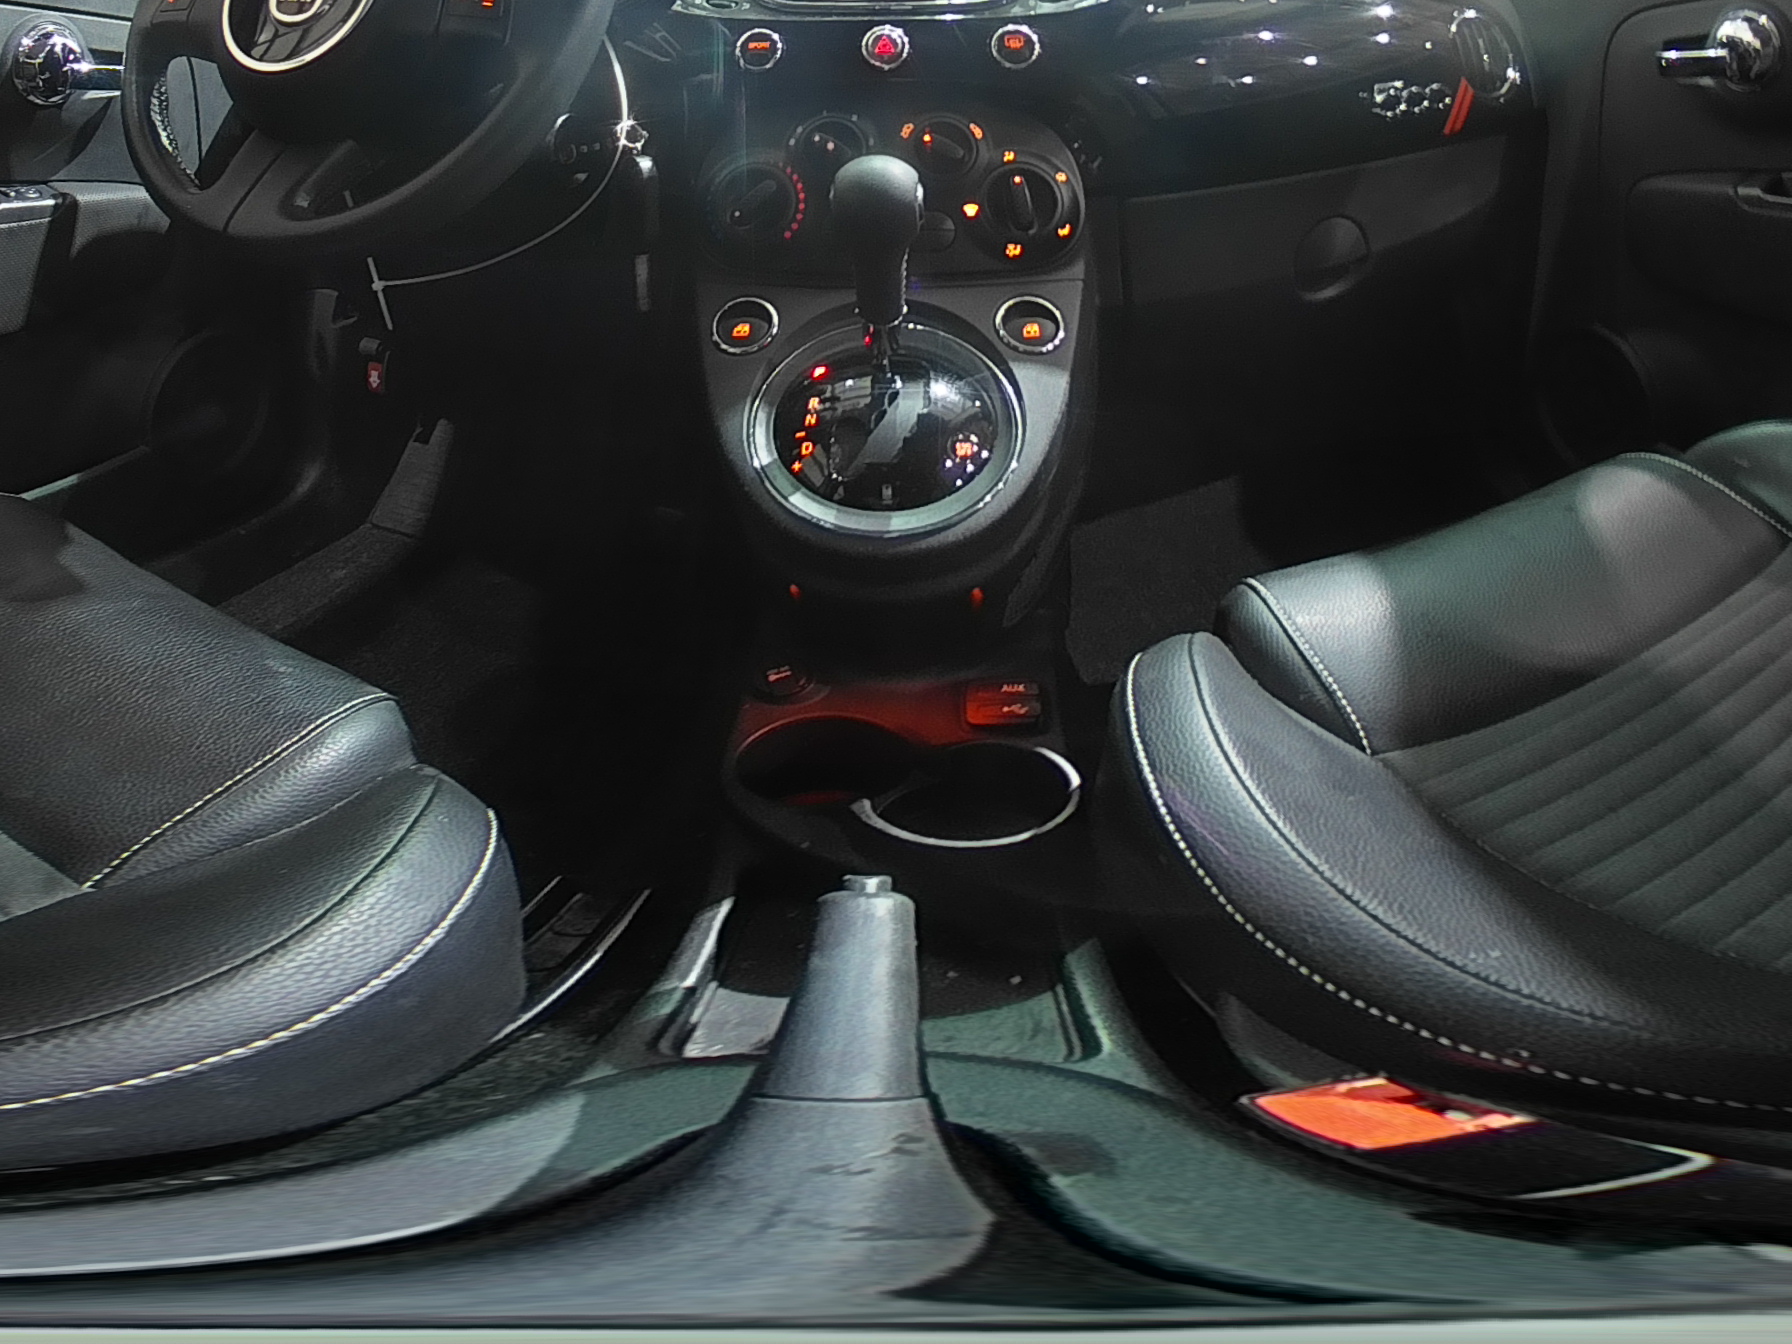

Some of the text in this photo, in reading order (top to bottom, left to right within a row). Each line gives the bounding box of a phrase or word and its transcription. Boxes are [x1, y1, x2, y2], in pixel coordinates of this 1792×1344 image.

[807, 396, 820, 410] R
[804, 413, 817, 427] N
[800, 441, 813, 456] D
[1000, 683, 1026, 693] AUX
